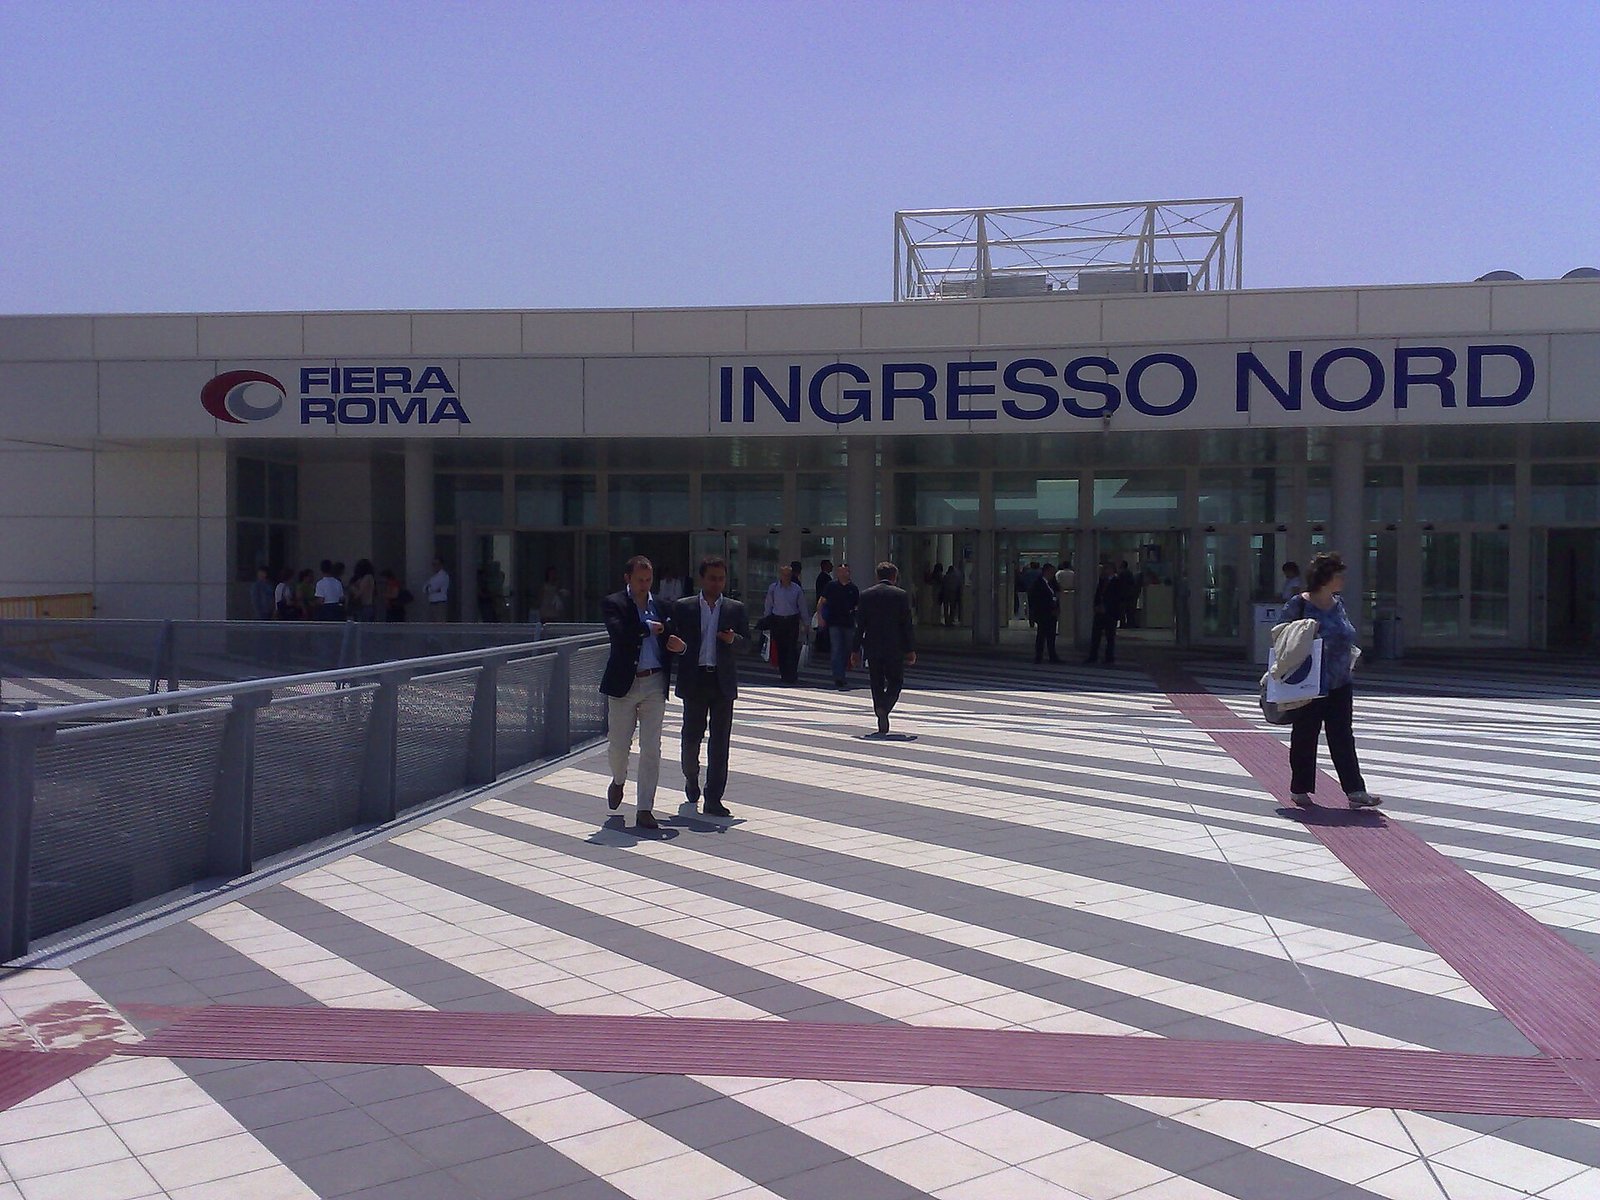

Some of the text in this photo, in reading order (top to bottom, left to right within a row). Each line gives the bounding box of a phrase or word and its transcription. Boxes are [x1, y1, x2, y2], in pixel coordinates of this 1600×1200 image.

[300, 366, 456, 394] FIERA
[719, 345, 1535, 423] INGRESSO NORD
[300, 397, 472, 425] ROMA
